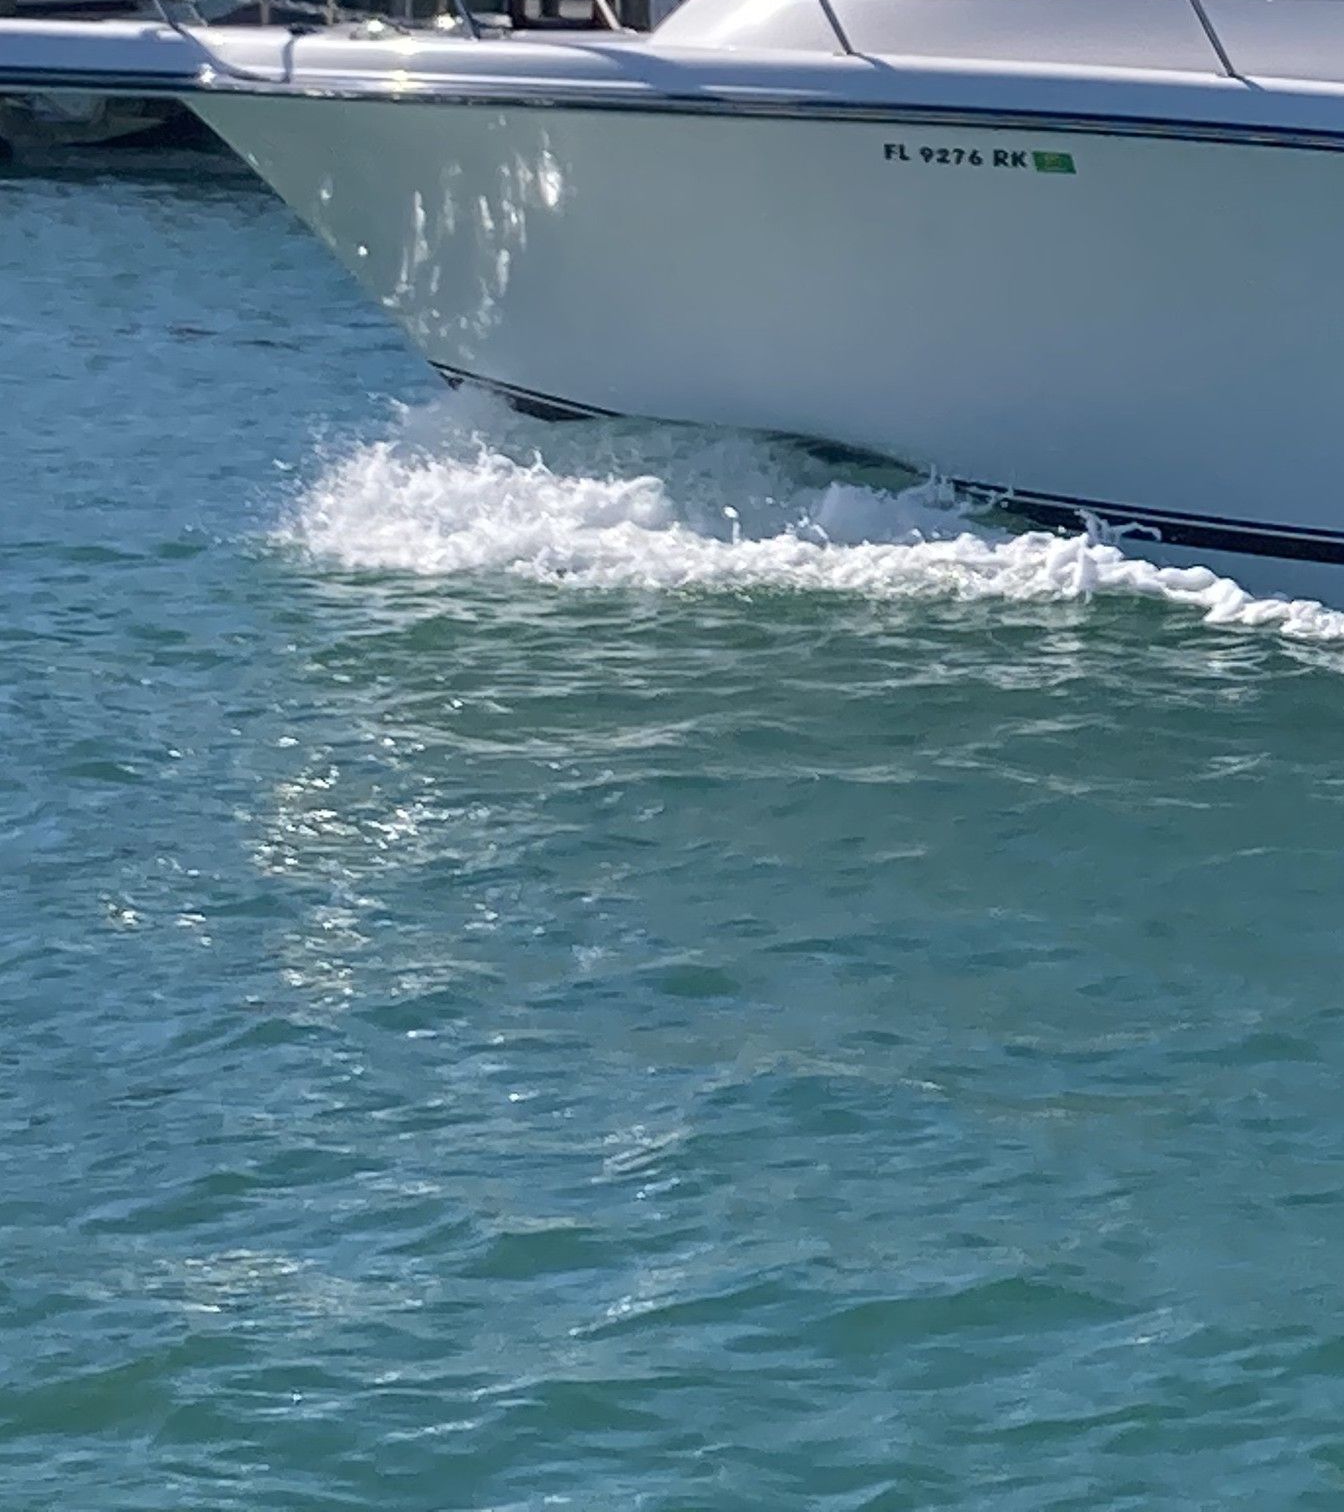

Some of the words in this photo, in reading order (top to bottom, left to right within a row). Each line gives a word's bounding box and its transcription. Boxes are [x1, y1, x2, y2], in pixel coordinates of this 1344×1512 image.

[883, 143, 911, 161] FL
[919, 146, 984, 165] 9276
[993, 149, 1028, 168] RK
